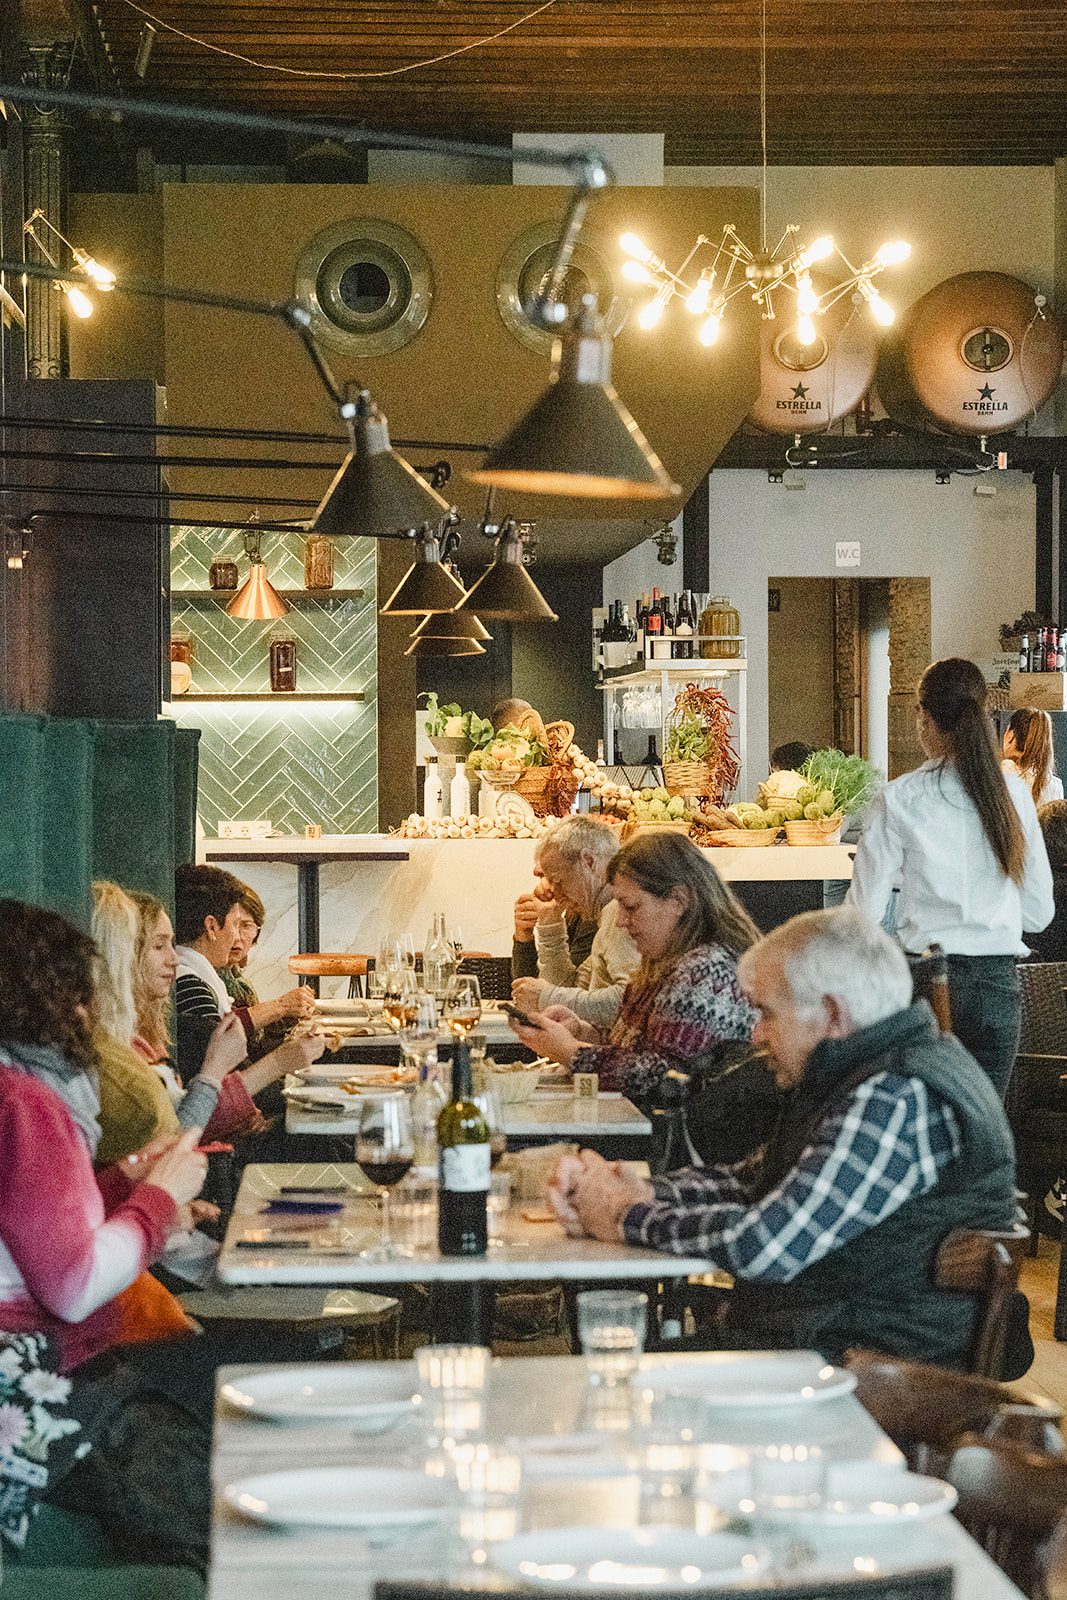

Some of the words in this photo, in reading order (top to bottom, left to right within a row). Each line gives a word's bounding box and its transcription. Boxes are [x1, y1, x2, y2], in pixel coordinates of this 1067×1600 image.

[776, 401, 822, 410] ESTRELLA
[962, 402, 1008, 411] ESTRELLA
[837, 549, 859, 559] W.C
